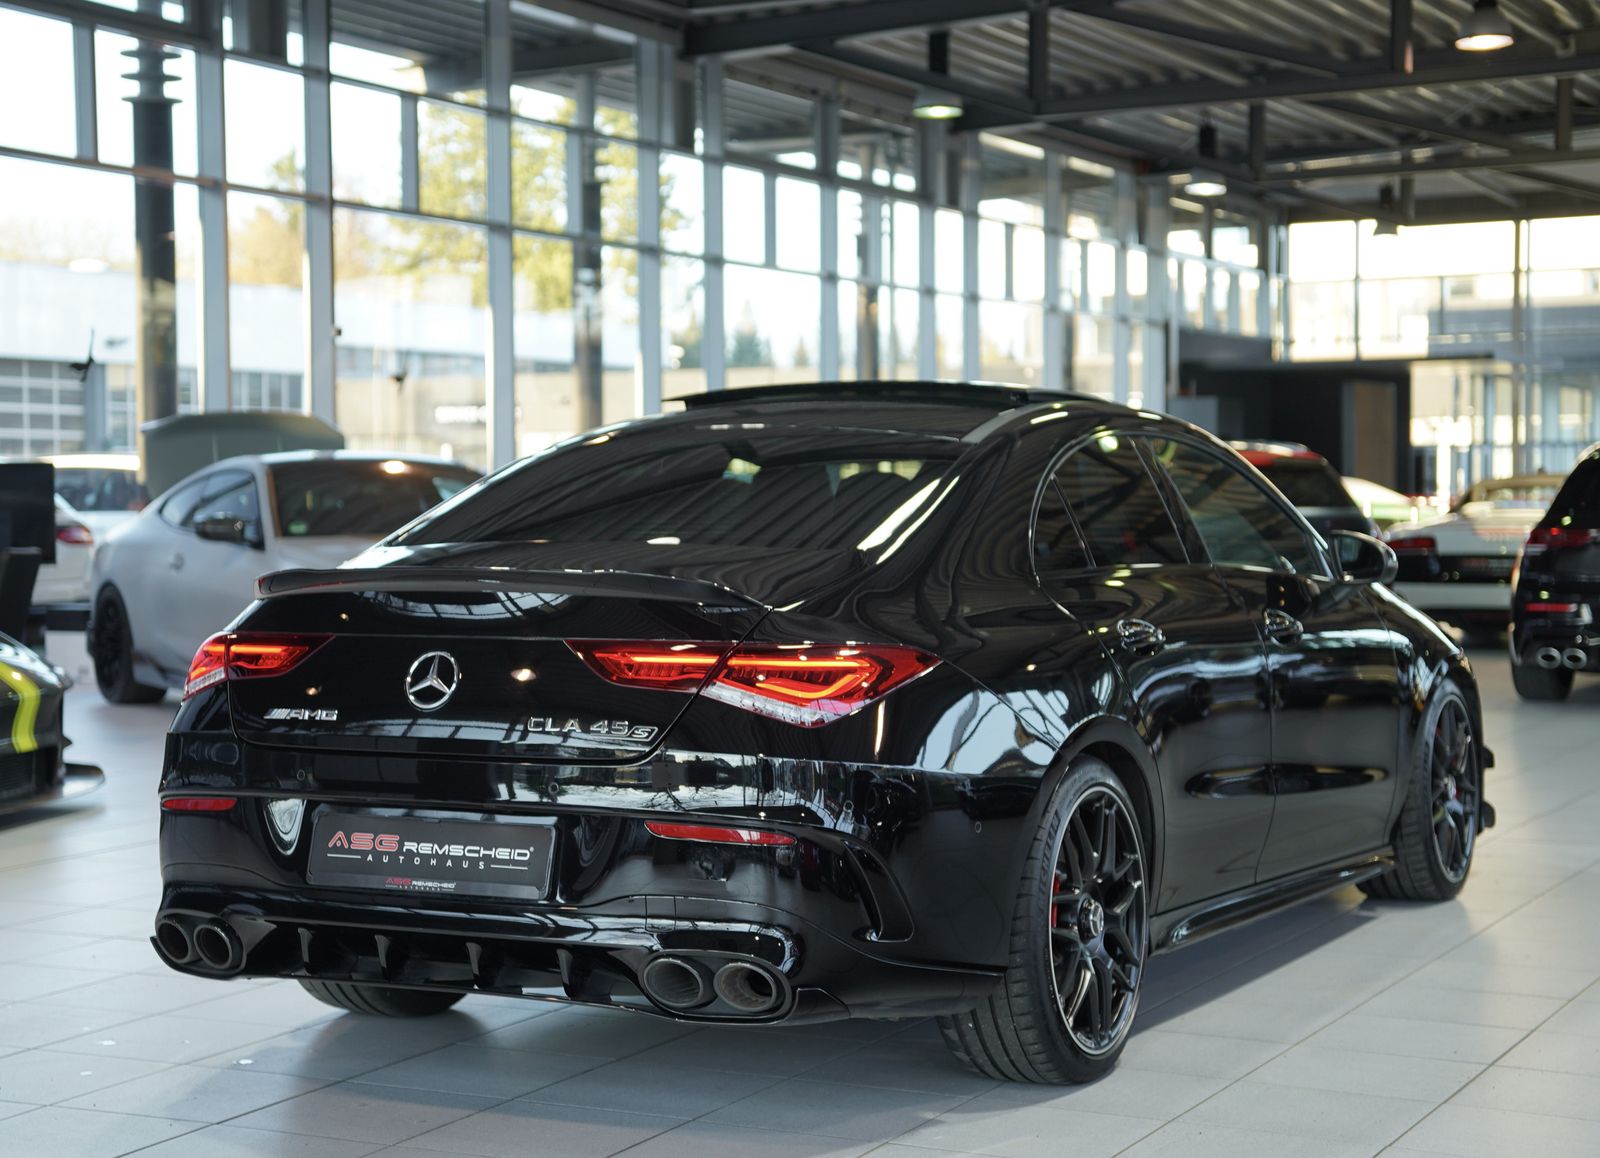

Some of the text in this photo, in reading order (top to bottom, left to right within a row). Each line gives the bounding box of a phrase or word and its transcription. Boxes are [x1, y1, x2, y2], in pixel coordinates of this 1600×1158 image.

[284, 708, 338, 721] AMG
[527, 717, 582, 733] CLA
[590, 721, 628, 734] 45
[328, 830, 400, 851] ASG
[366, 854, 485, 869] AUTOHAUS
